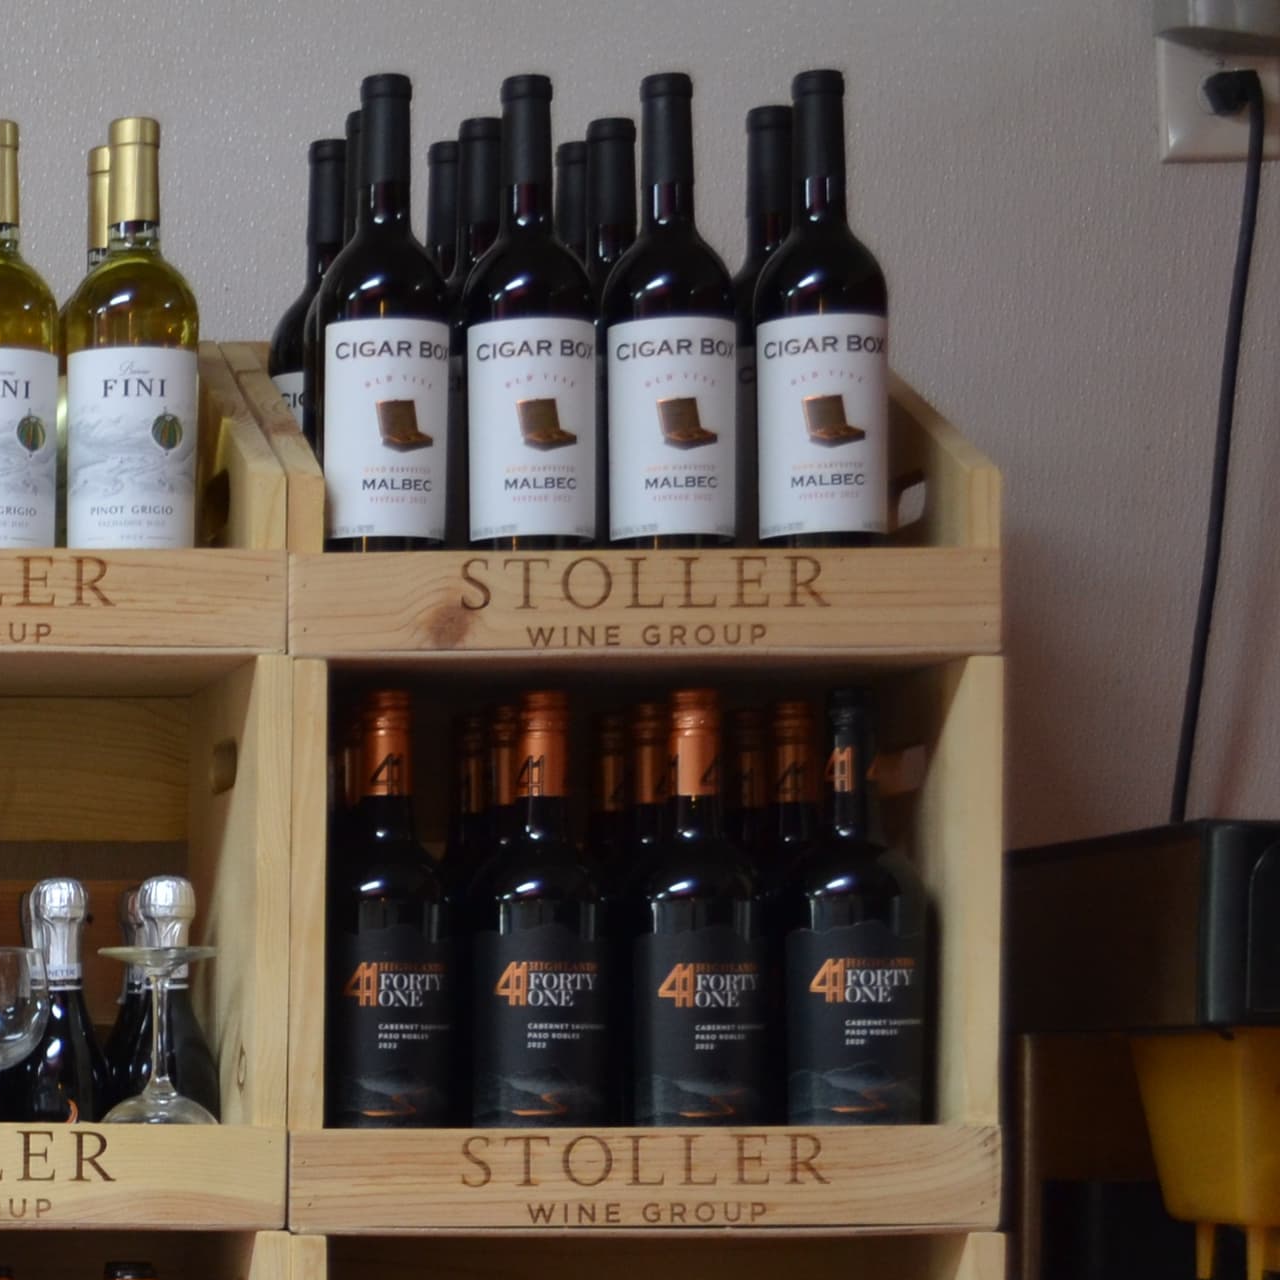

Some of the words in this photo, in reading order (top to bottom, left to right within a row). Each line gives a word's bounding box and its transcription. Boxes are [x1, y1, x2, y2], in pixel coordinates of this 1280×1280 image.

[335, 340, 412, 361] CIGAR
[476, 339, 552, 362] CIGAR
[616, 338, 693, 361] CIGAR
[700, 338, 735, 359] BOX
[764, 335, 839, 360] CIGAR
[846, 334, 886, 354] BOX
[103, 378, 167, 398] FINI
[362, 478, 432, 492] MALBEC
[504, 477, 577, 491] MALBEC
[645, 476, 718, 490] MALBEC
[791, 474, 865, 488] MALBEC
[460, 556, 831, 611] STOLLER
[527, 625, 620, 646] WINE
[642, 624, 768, 646] GROUP
[379, 972, 444, 991] FORTY
[528, 972, 598, 991] FORTY
[846, 969, 914, 987] FORTY
[378, 990, 423, 1007] ONE
[527, 990, 574, 1007] ONE
[845, 986, 891, 1003] ONE
[461, 1133, 830, 1187] STOLLER
[527, 1203, 621, 1224] WINE
[643, 1202, 768, 1223] GROUP
